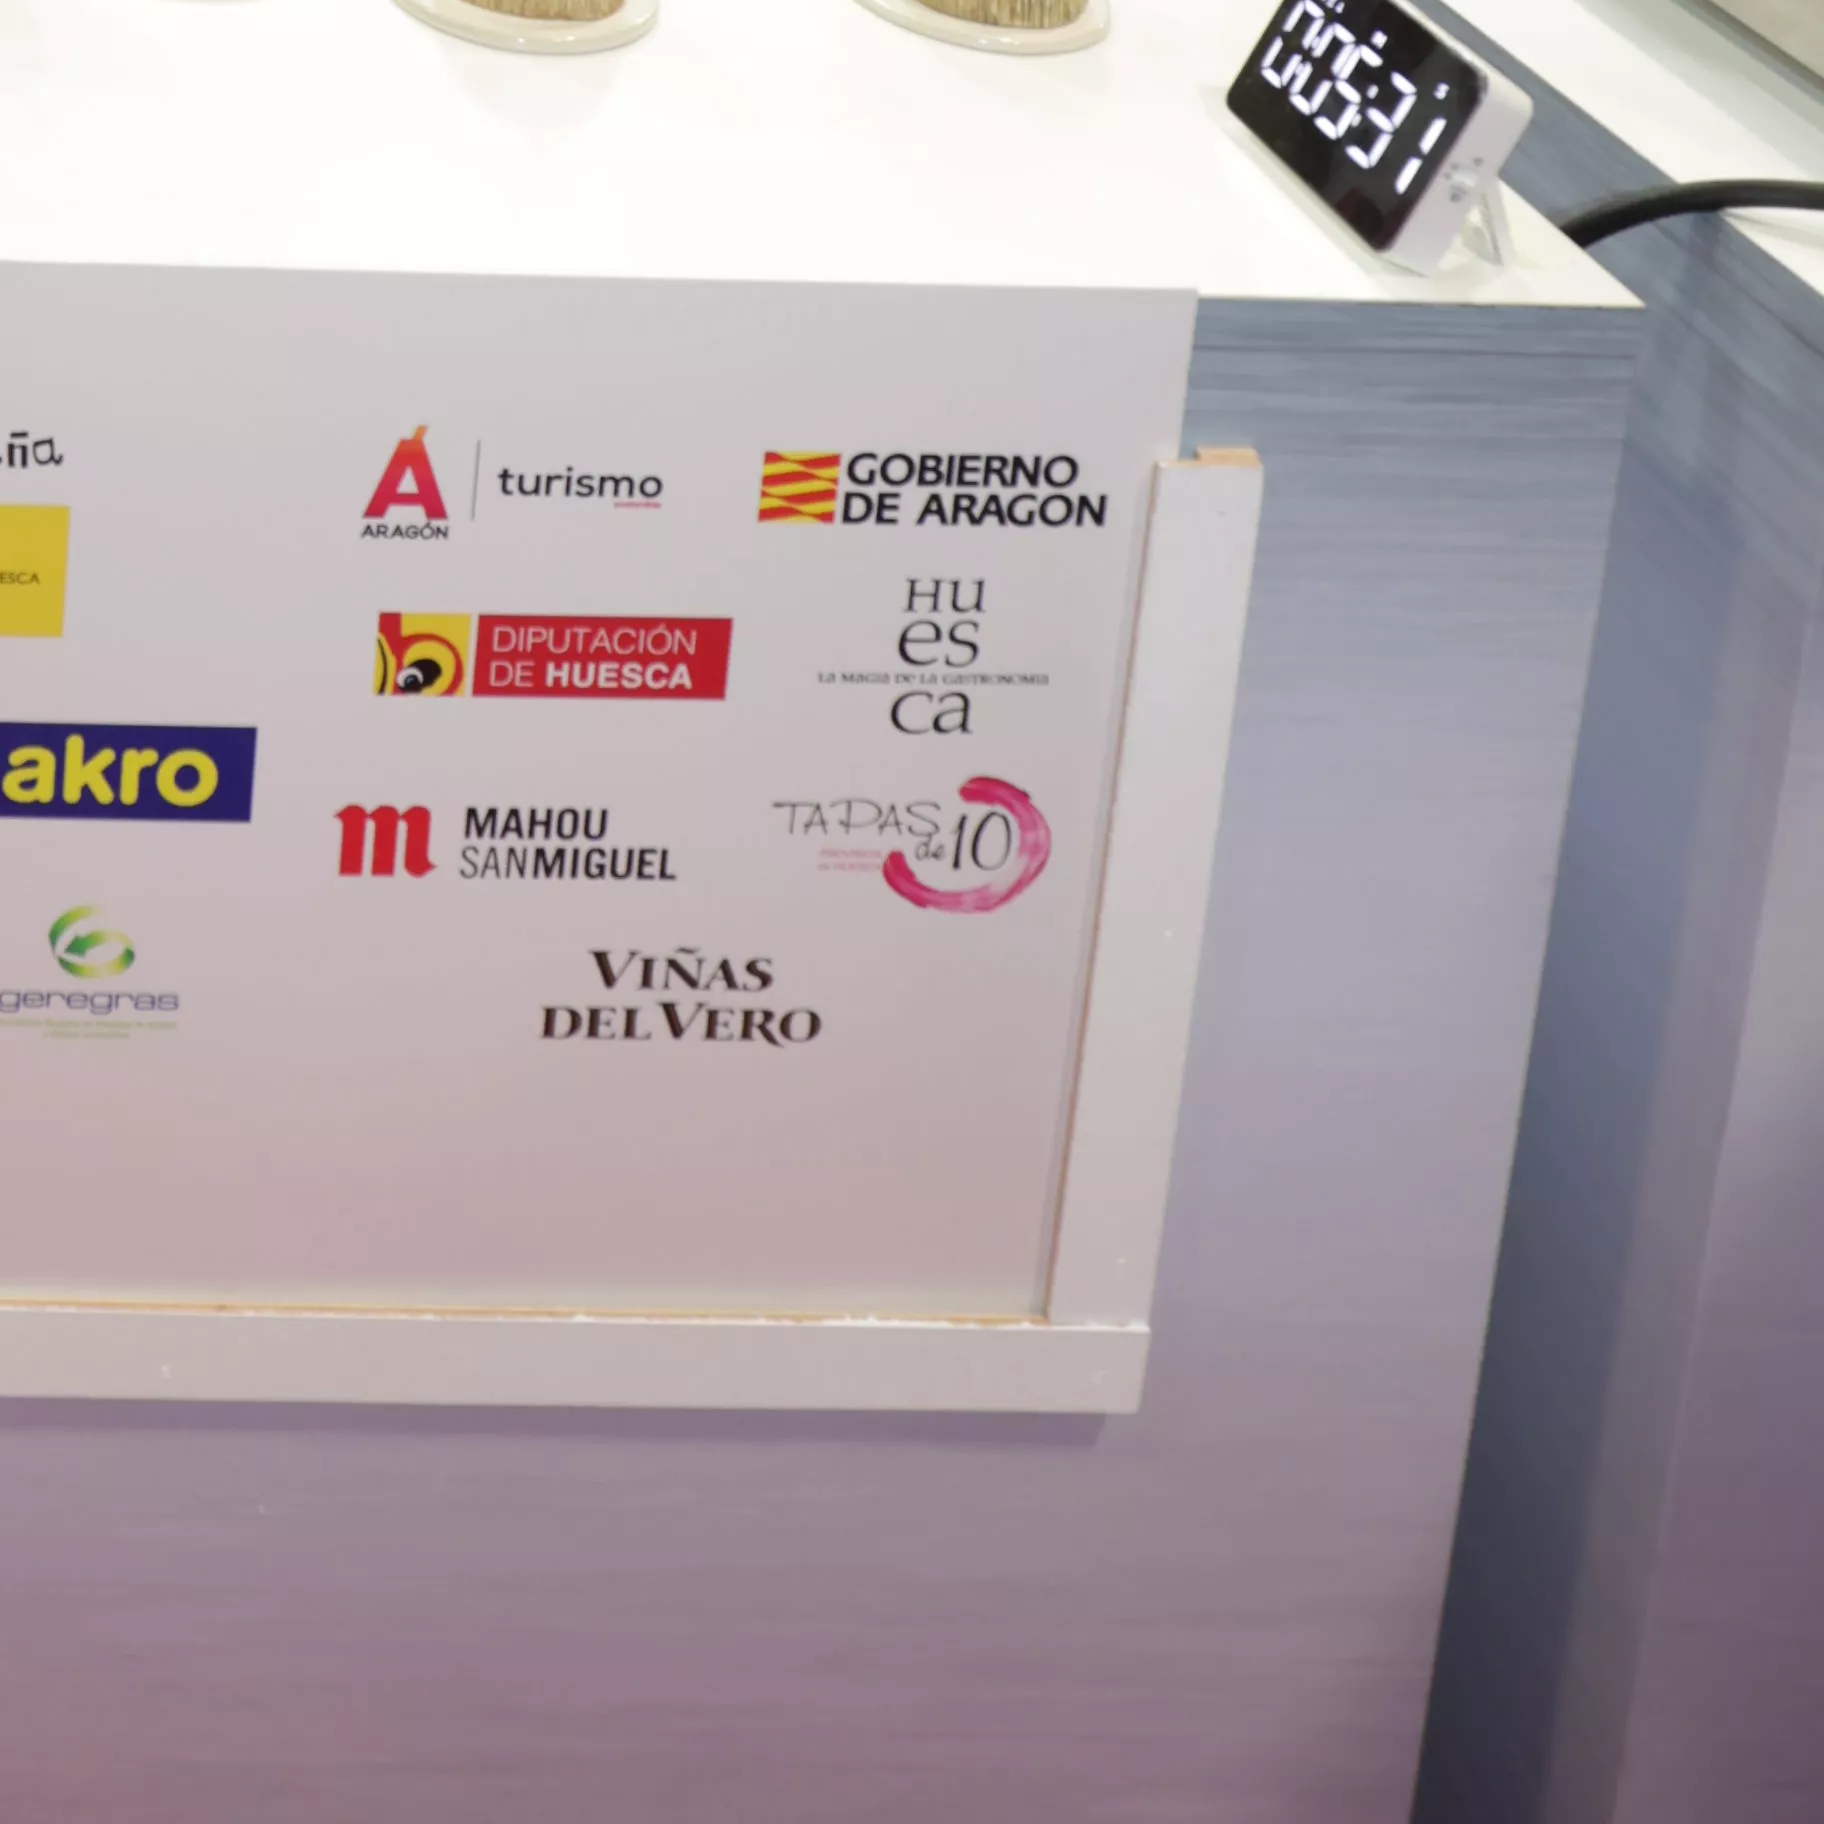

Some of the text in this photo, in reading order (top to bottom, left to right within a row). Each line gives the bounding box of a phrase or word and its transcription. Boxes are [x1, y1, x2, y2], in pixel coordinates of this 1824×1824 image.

[498, 466, 663, 498] turismo
[847, 453, 1078, 488] GOBIERNO
[842, 494, 1107, 528] DE ARAGON
[361, 523, 448, 540] ARAGÓN
[492, 623, 697, 656] DIPUTACIÓN
[898, 619, 979, 668] es
[489, 662, 693, 692] DE HUESCA
[890, 690, 973, 734] ca
[464, 807, 607, 841] MAHOU
[773, 799, 941, 836] TAPAS
[915, 834, 944, 860] de
[952, 811, 1011, 870] 10
[460, 845, 675, 881] SANMIGUEL
[588, 949, 774, 993] VIÑAS
[540, 1002, 822, 1047] DEL VERO
